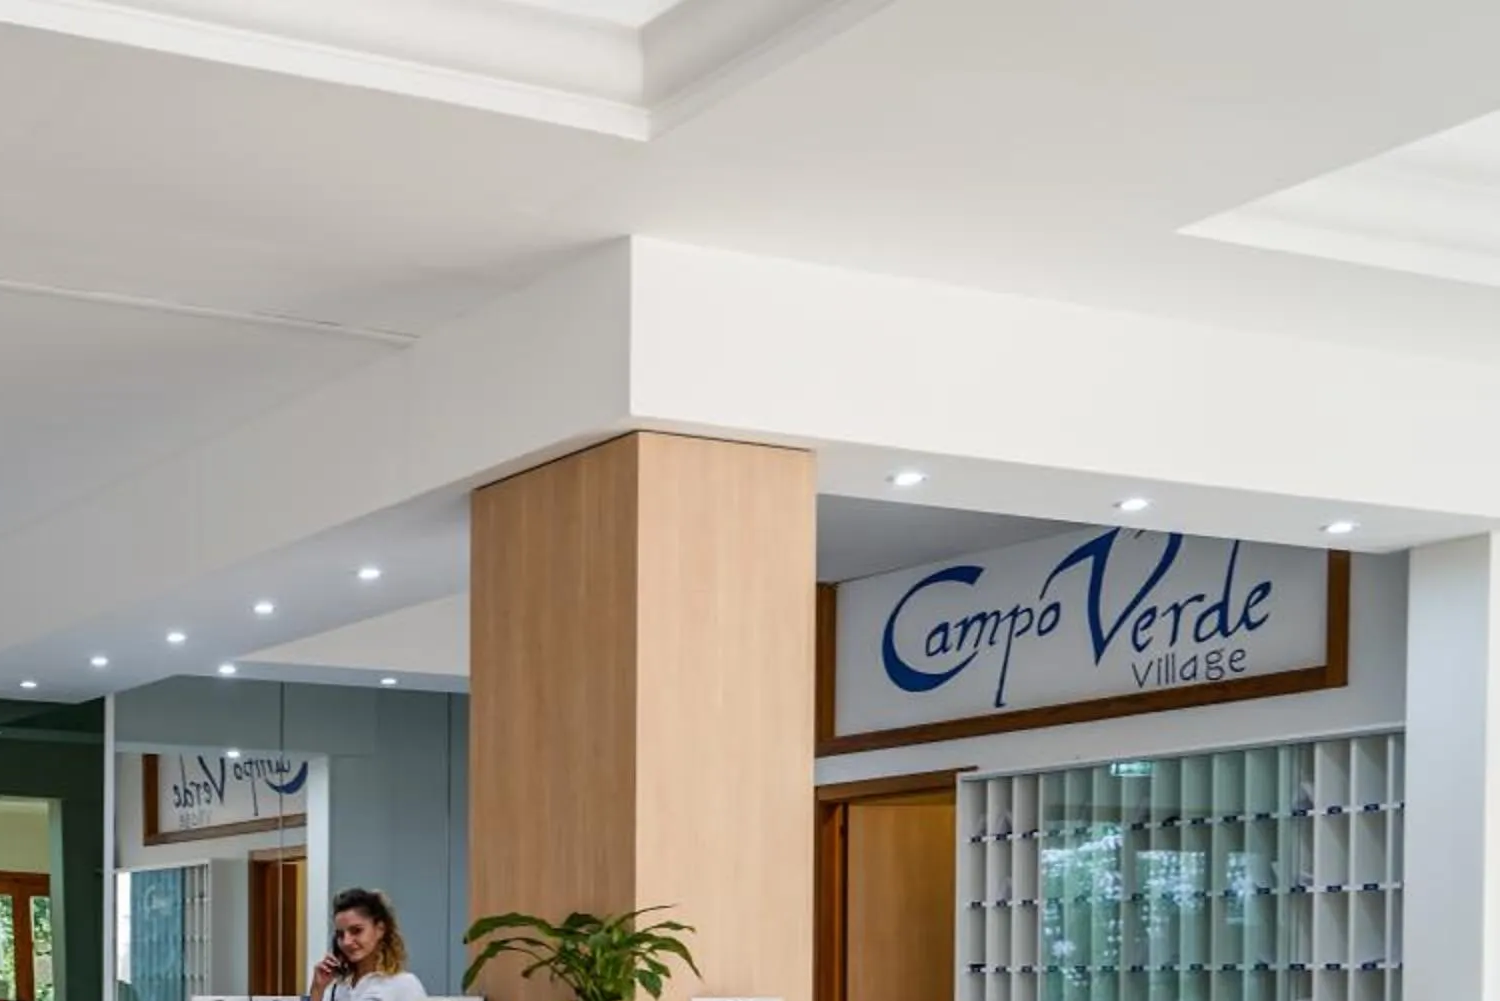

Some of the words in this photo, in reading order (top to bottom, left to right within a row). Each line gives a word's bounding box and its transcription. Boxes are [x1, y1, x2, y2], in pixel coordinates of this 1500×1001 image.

[882, 565, 1061, 708] Campo
[1040, 526, 1272, 667] Verde
[1131, 647, 1247, 689] Village
